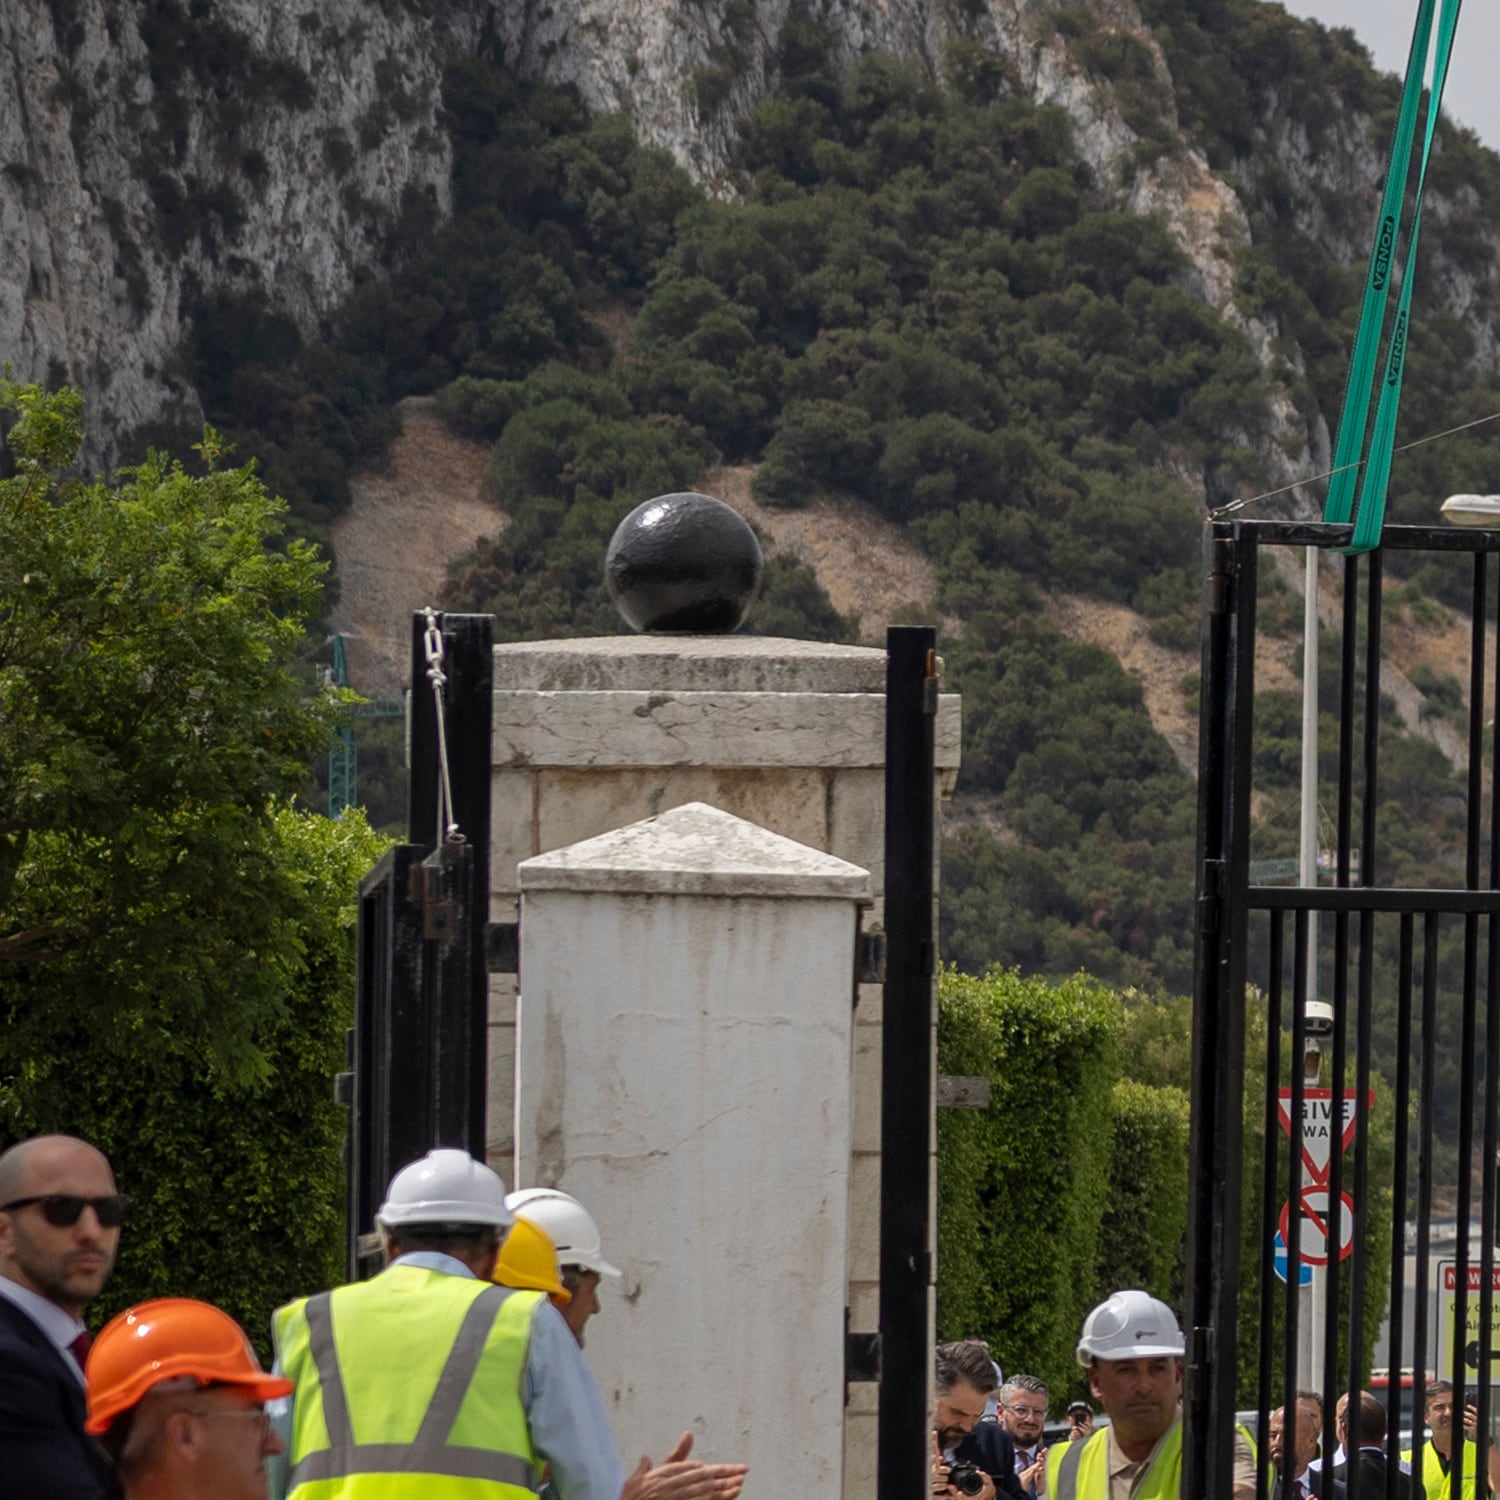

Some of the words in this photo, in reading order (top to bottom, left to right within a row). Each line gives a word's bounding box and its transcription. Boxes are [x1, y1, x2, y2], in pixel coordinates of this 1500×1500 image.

[1374, 220, 1394, 286] PONSA
[1389, 316, 1406, 382] PONSA
[1448, 1272, 1481, 1285] NW
[1450, 1304, 1471, 1313] Cy
